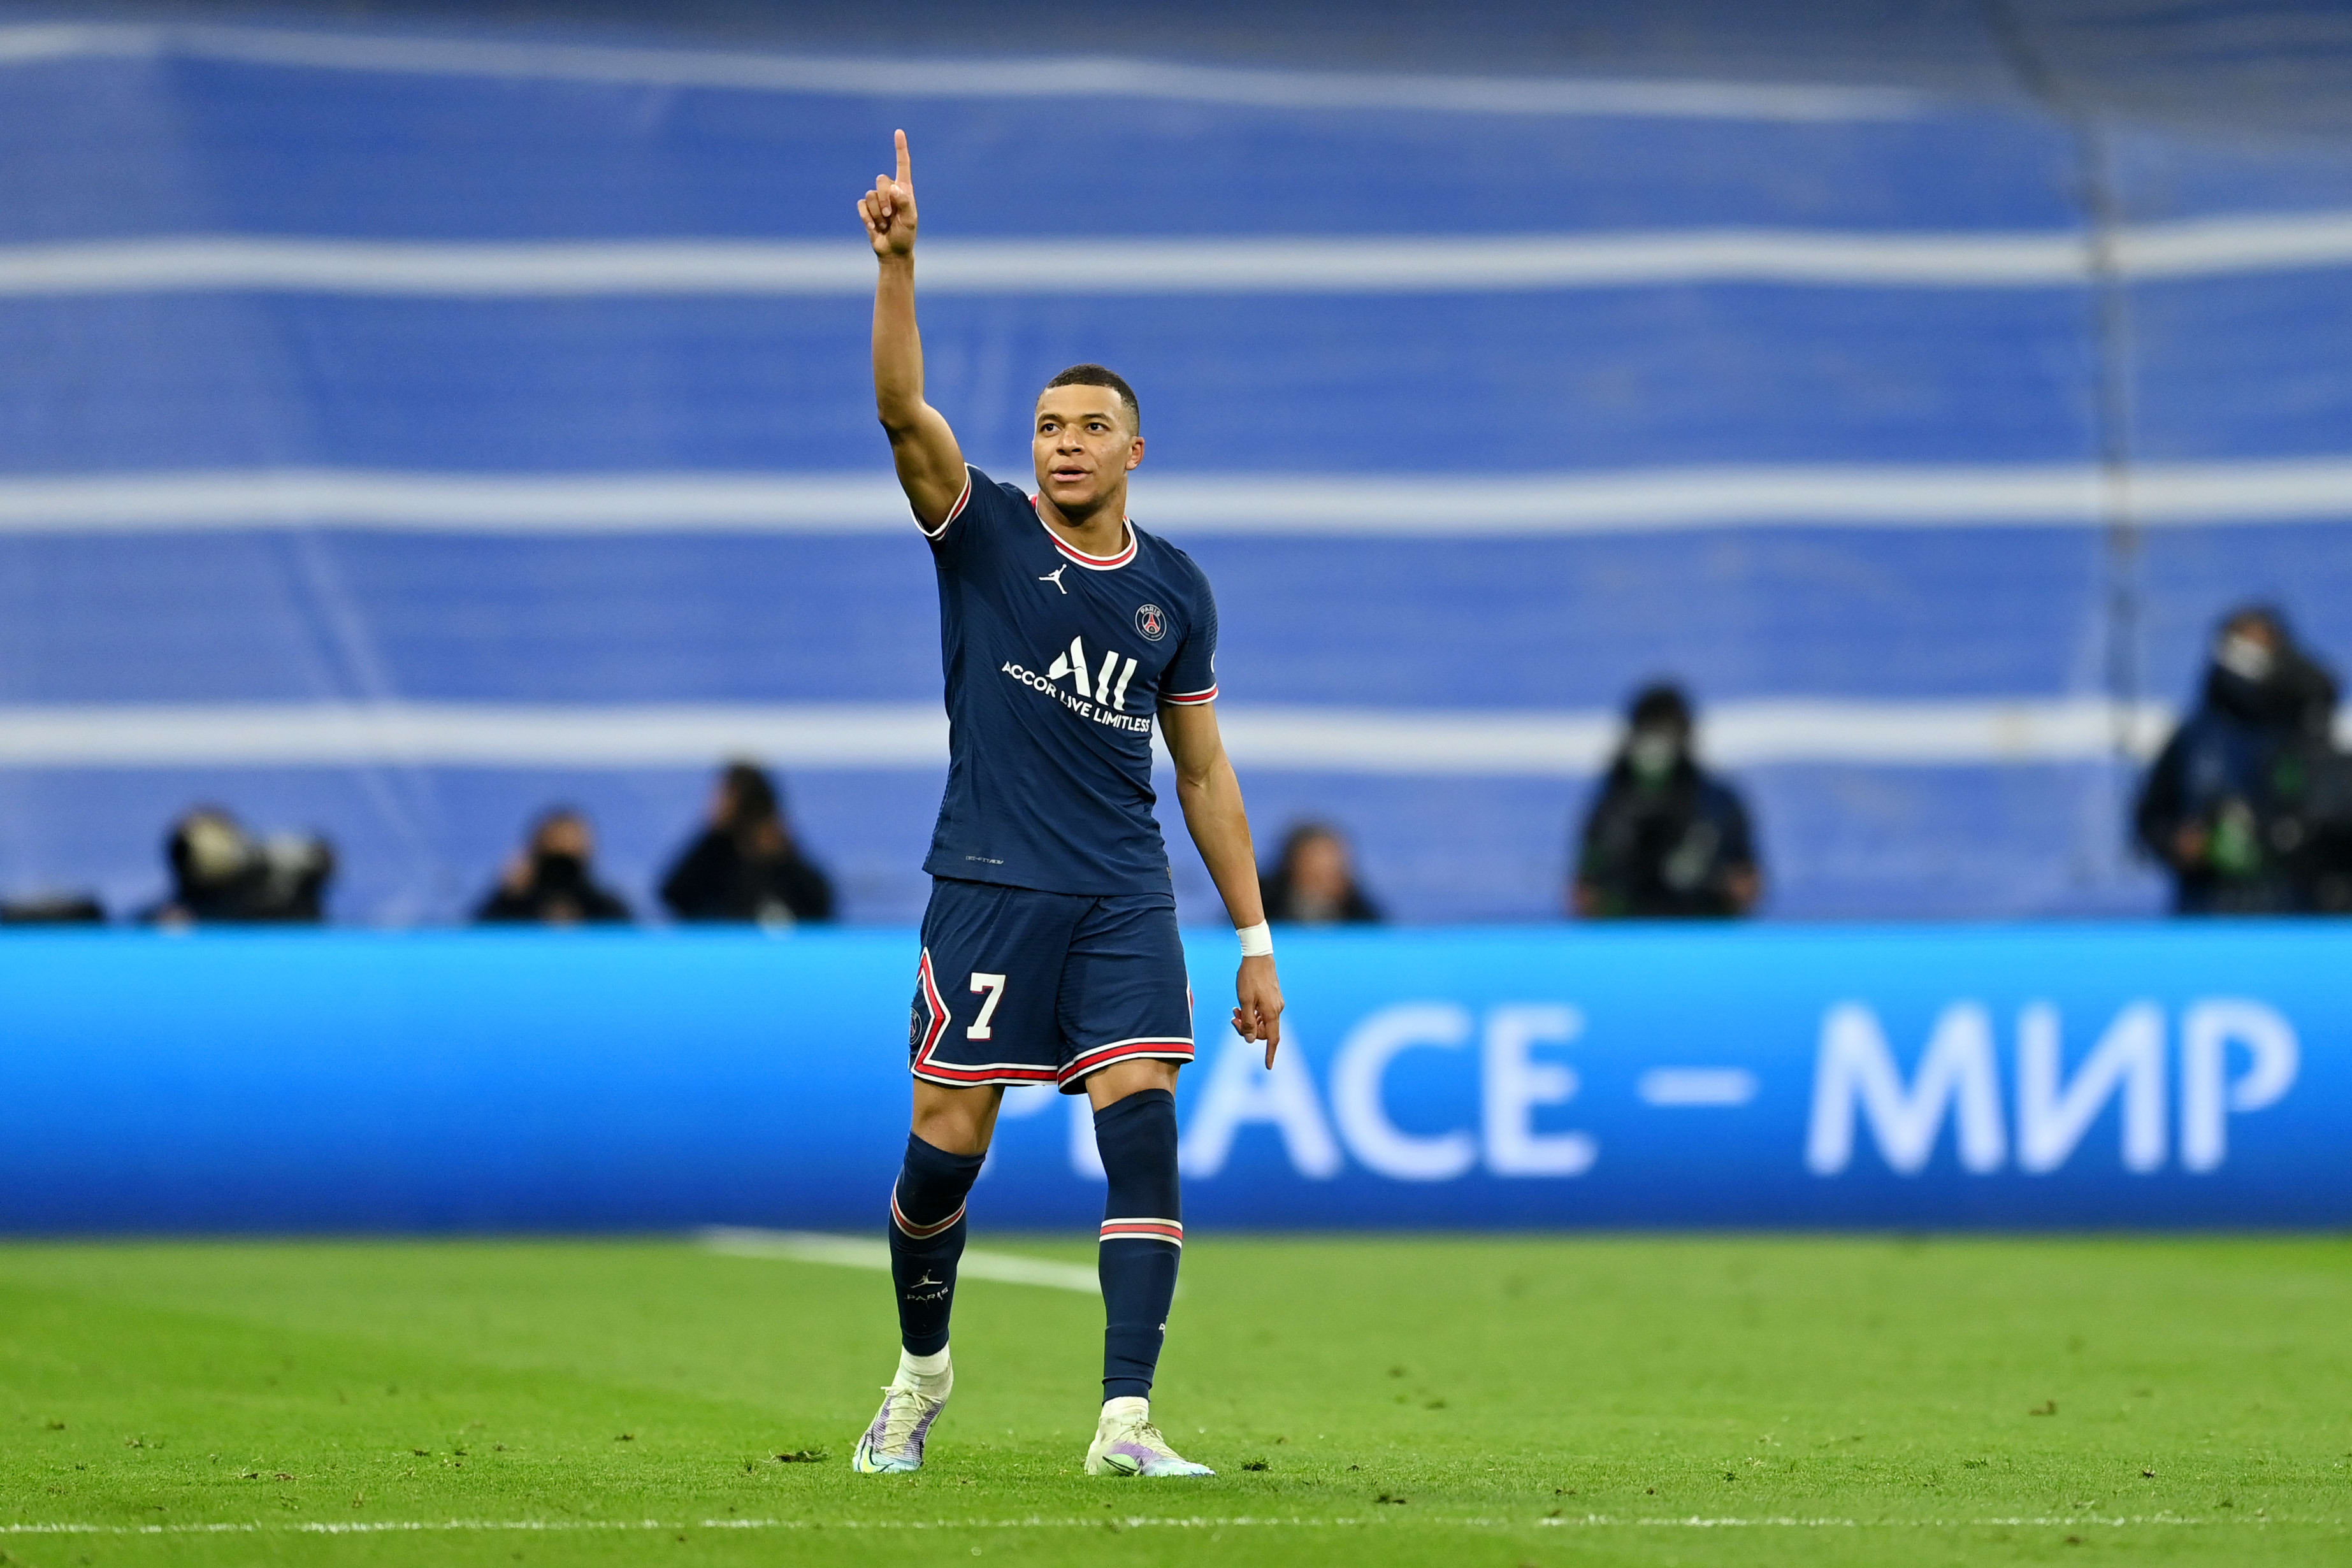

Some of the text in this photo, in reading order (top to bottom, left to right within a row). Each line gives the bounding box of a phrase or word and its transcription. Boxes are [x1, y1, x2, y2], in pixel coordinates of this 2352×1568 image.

[1141, 606, 1160, 617] PARIS
[1001, 661, 1150, 733] ACCOR LIVE LIMITLESS
[967, 972, 1006, 1040] 7
[976, 1000, 1599, 1182] ACE
[1807, 998, 2300, 1176] МИР
[907, 1286, 948, 1301] PARIS
